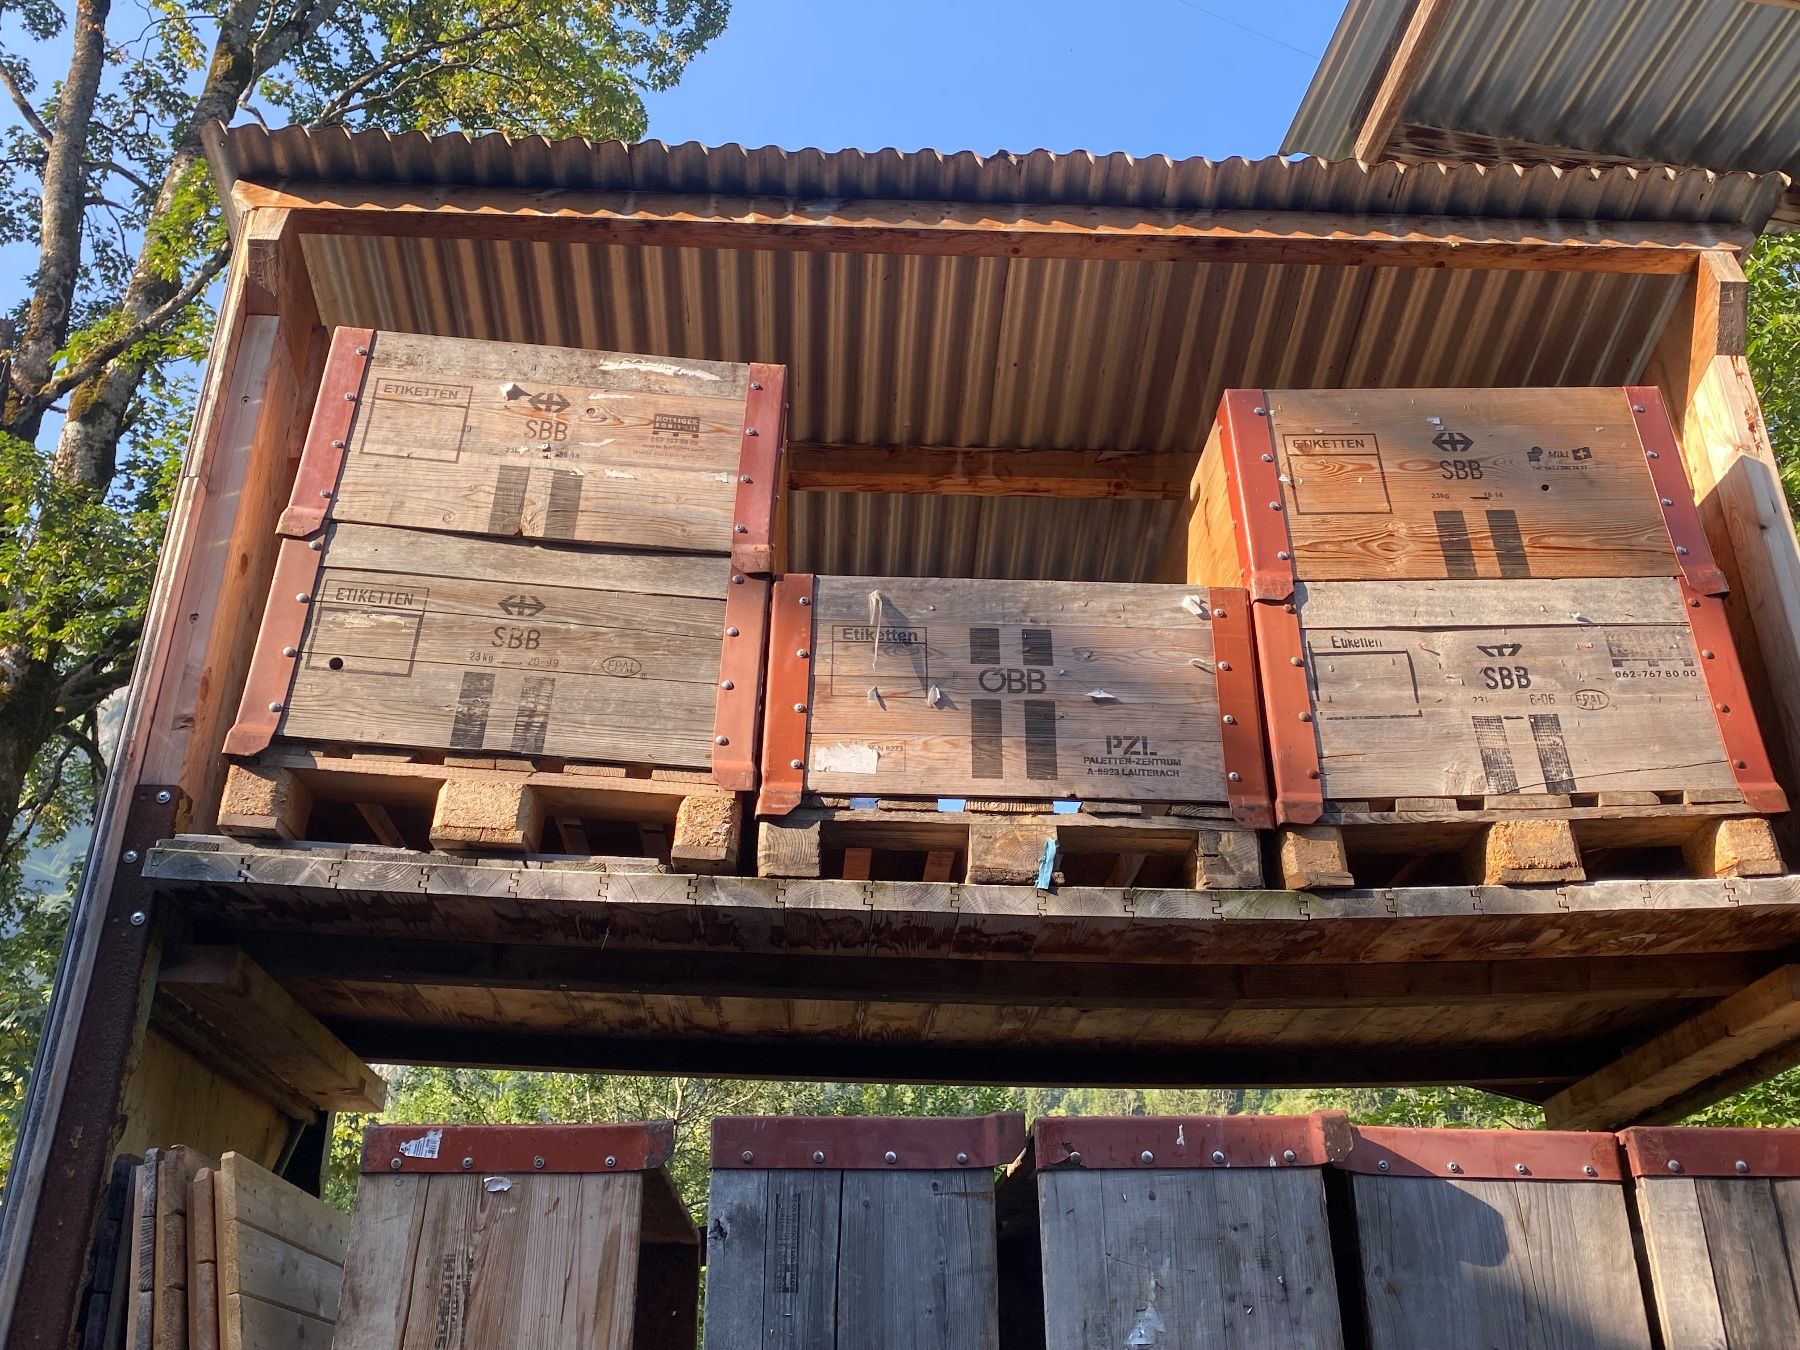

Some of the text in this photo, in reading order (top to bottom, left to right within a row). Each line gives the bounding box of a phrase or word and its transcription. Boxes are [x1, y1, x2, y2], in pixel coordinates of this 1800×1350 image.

[383, 384, 459, 399] ETIKETTEN
[525, 419, 568, 441] SBB
[1293, 439, 1365, 449] ETIKETTEN
[1439, 460, 1483, 480] SBB
[1431, 492, 1450, 500] 23kg
[336, 588, 414, 606] ETIKETTEN
[491, 626, 541, 650] SBB
[842, 627, 918, 642] Etiketten
[469, 651, 481, 661] 23
[606, 659, 636, 674] EPAL
[1665, 670, 1680, 678] 80
[1683, 670, 1697, 678] 00
[978, 667, 1047, 694] ÖBB
[1483, 666, 1531, 689] SBB
[1106, 735, 1157, 756] PZL
[1083, 756, 1182, 767] PALETTEN-ZENTRUM
[1121, 768, 1180, 777] LAUTERACH
